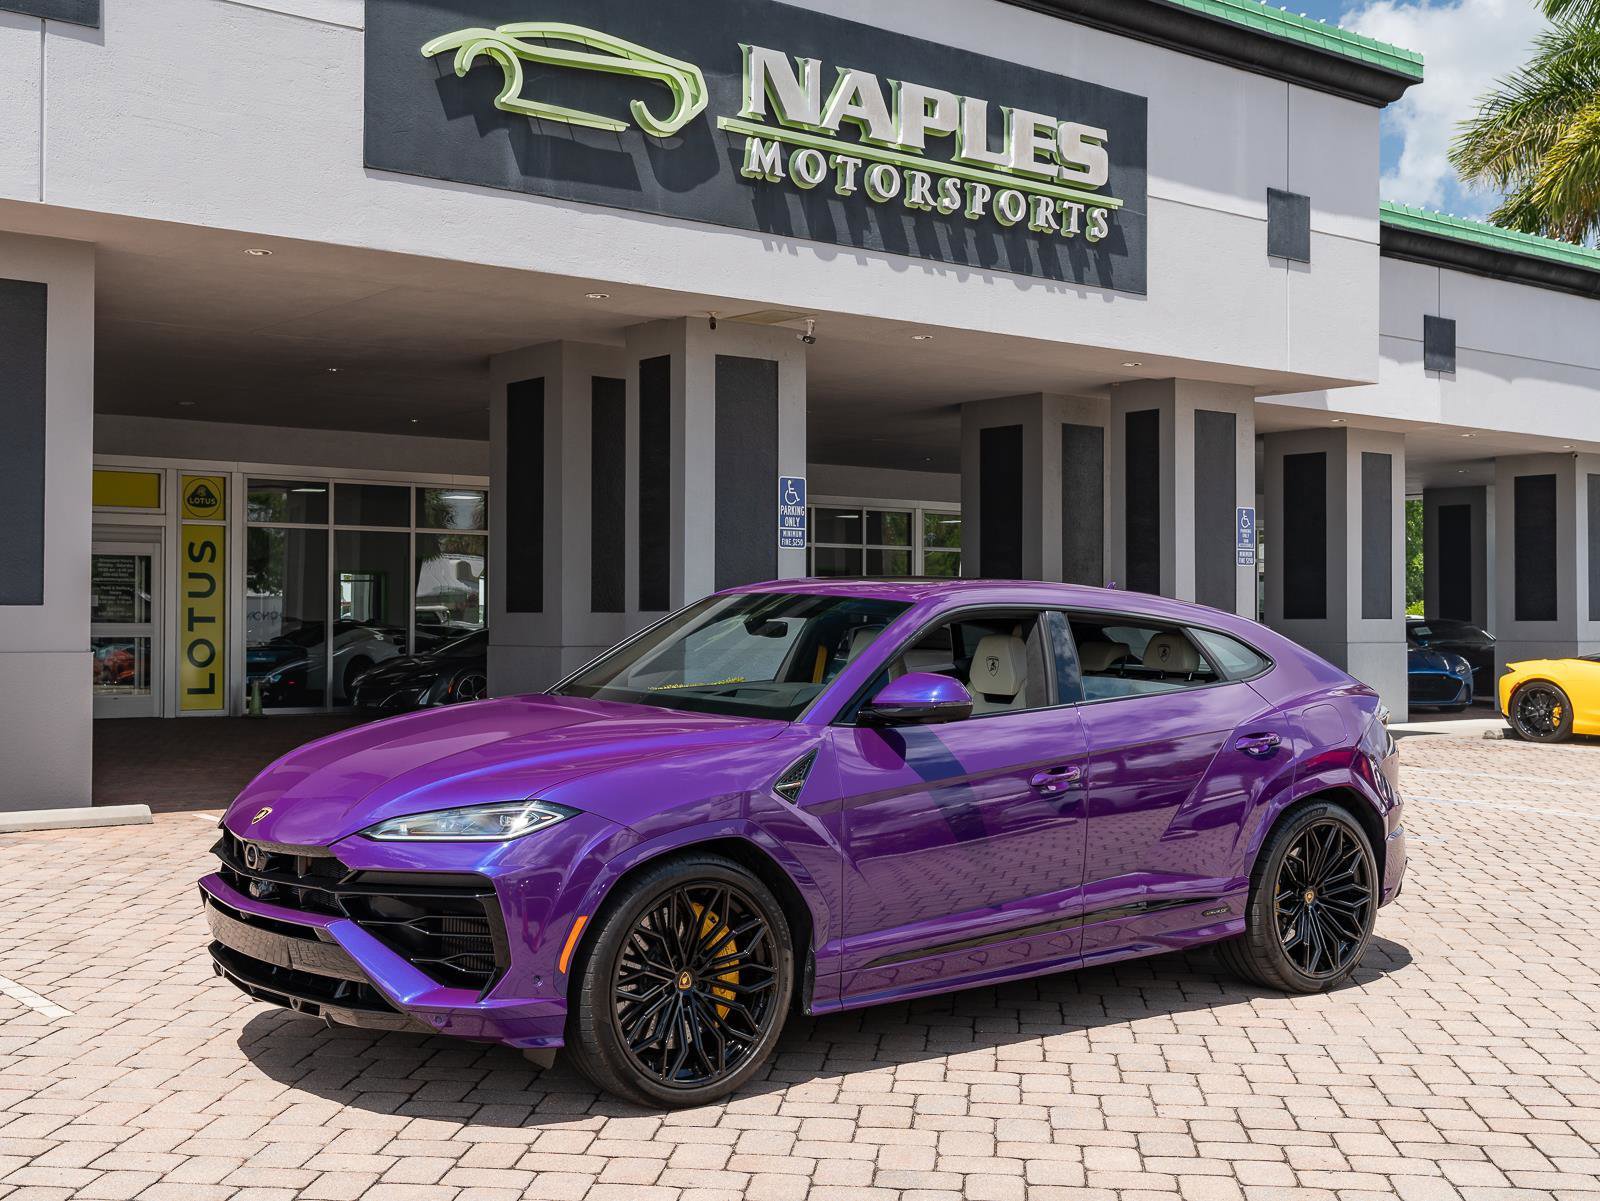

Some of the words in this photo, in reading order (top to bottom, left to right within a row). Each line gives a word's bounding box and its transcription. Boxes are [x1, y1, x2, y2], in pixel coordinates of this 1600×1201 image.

[738, 43, 1109, 190] NAPLES
[741, 137, 1110, 242] MOTORSPORTS
[189, 497, 216, 505] LOTUS
[781, 505, 804, 516] PARKING
[785, 517, 800, 527] ONLY
[187, 540, 217, 695] LOTUS
